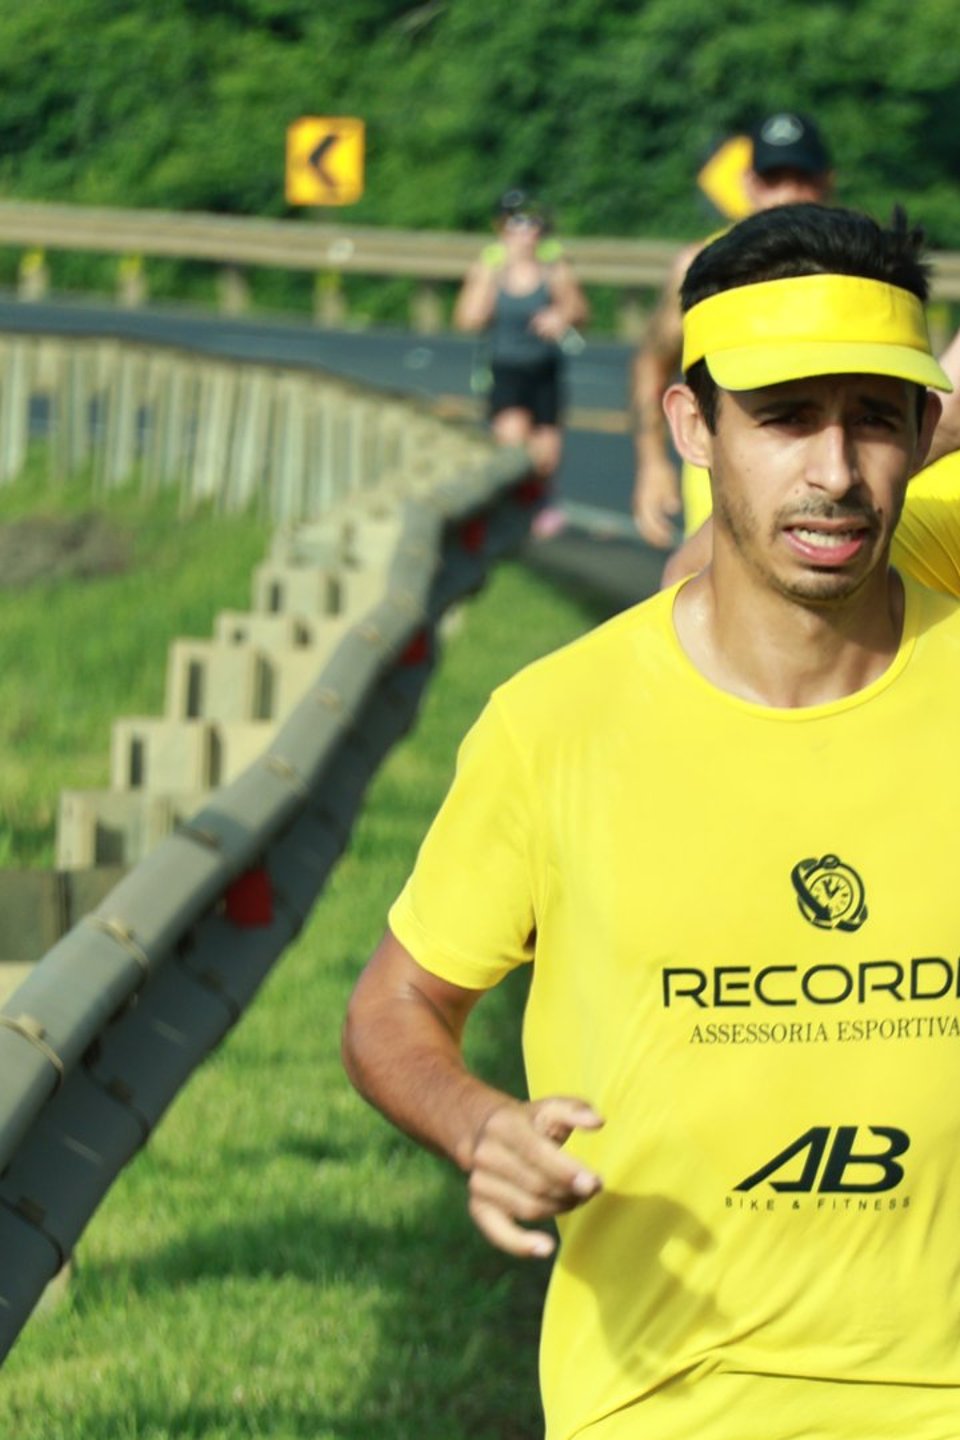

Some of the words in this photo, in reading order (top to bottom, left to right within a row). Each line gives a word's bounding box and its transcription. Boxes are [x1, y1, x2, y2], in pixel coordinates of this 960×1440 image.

[689, 1022, 828, 1044] ASSESSORIA
[837, 1016, 960, 1042] ESPORTIVA
[731, 1125, 911, 1194] AB
[724, 1195, 775, 1211] BIKE
[791, 1199, 801, 1211] &
[816, 1194, 911, 1212] FITNESS
